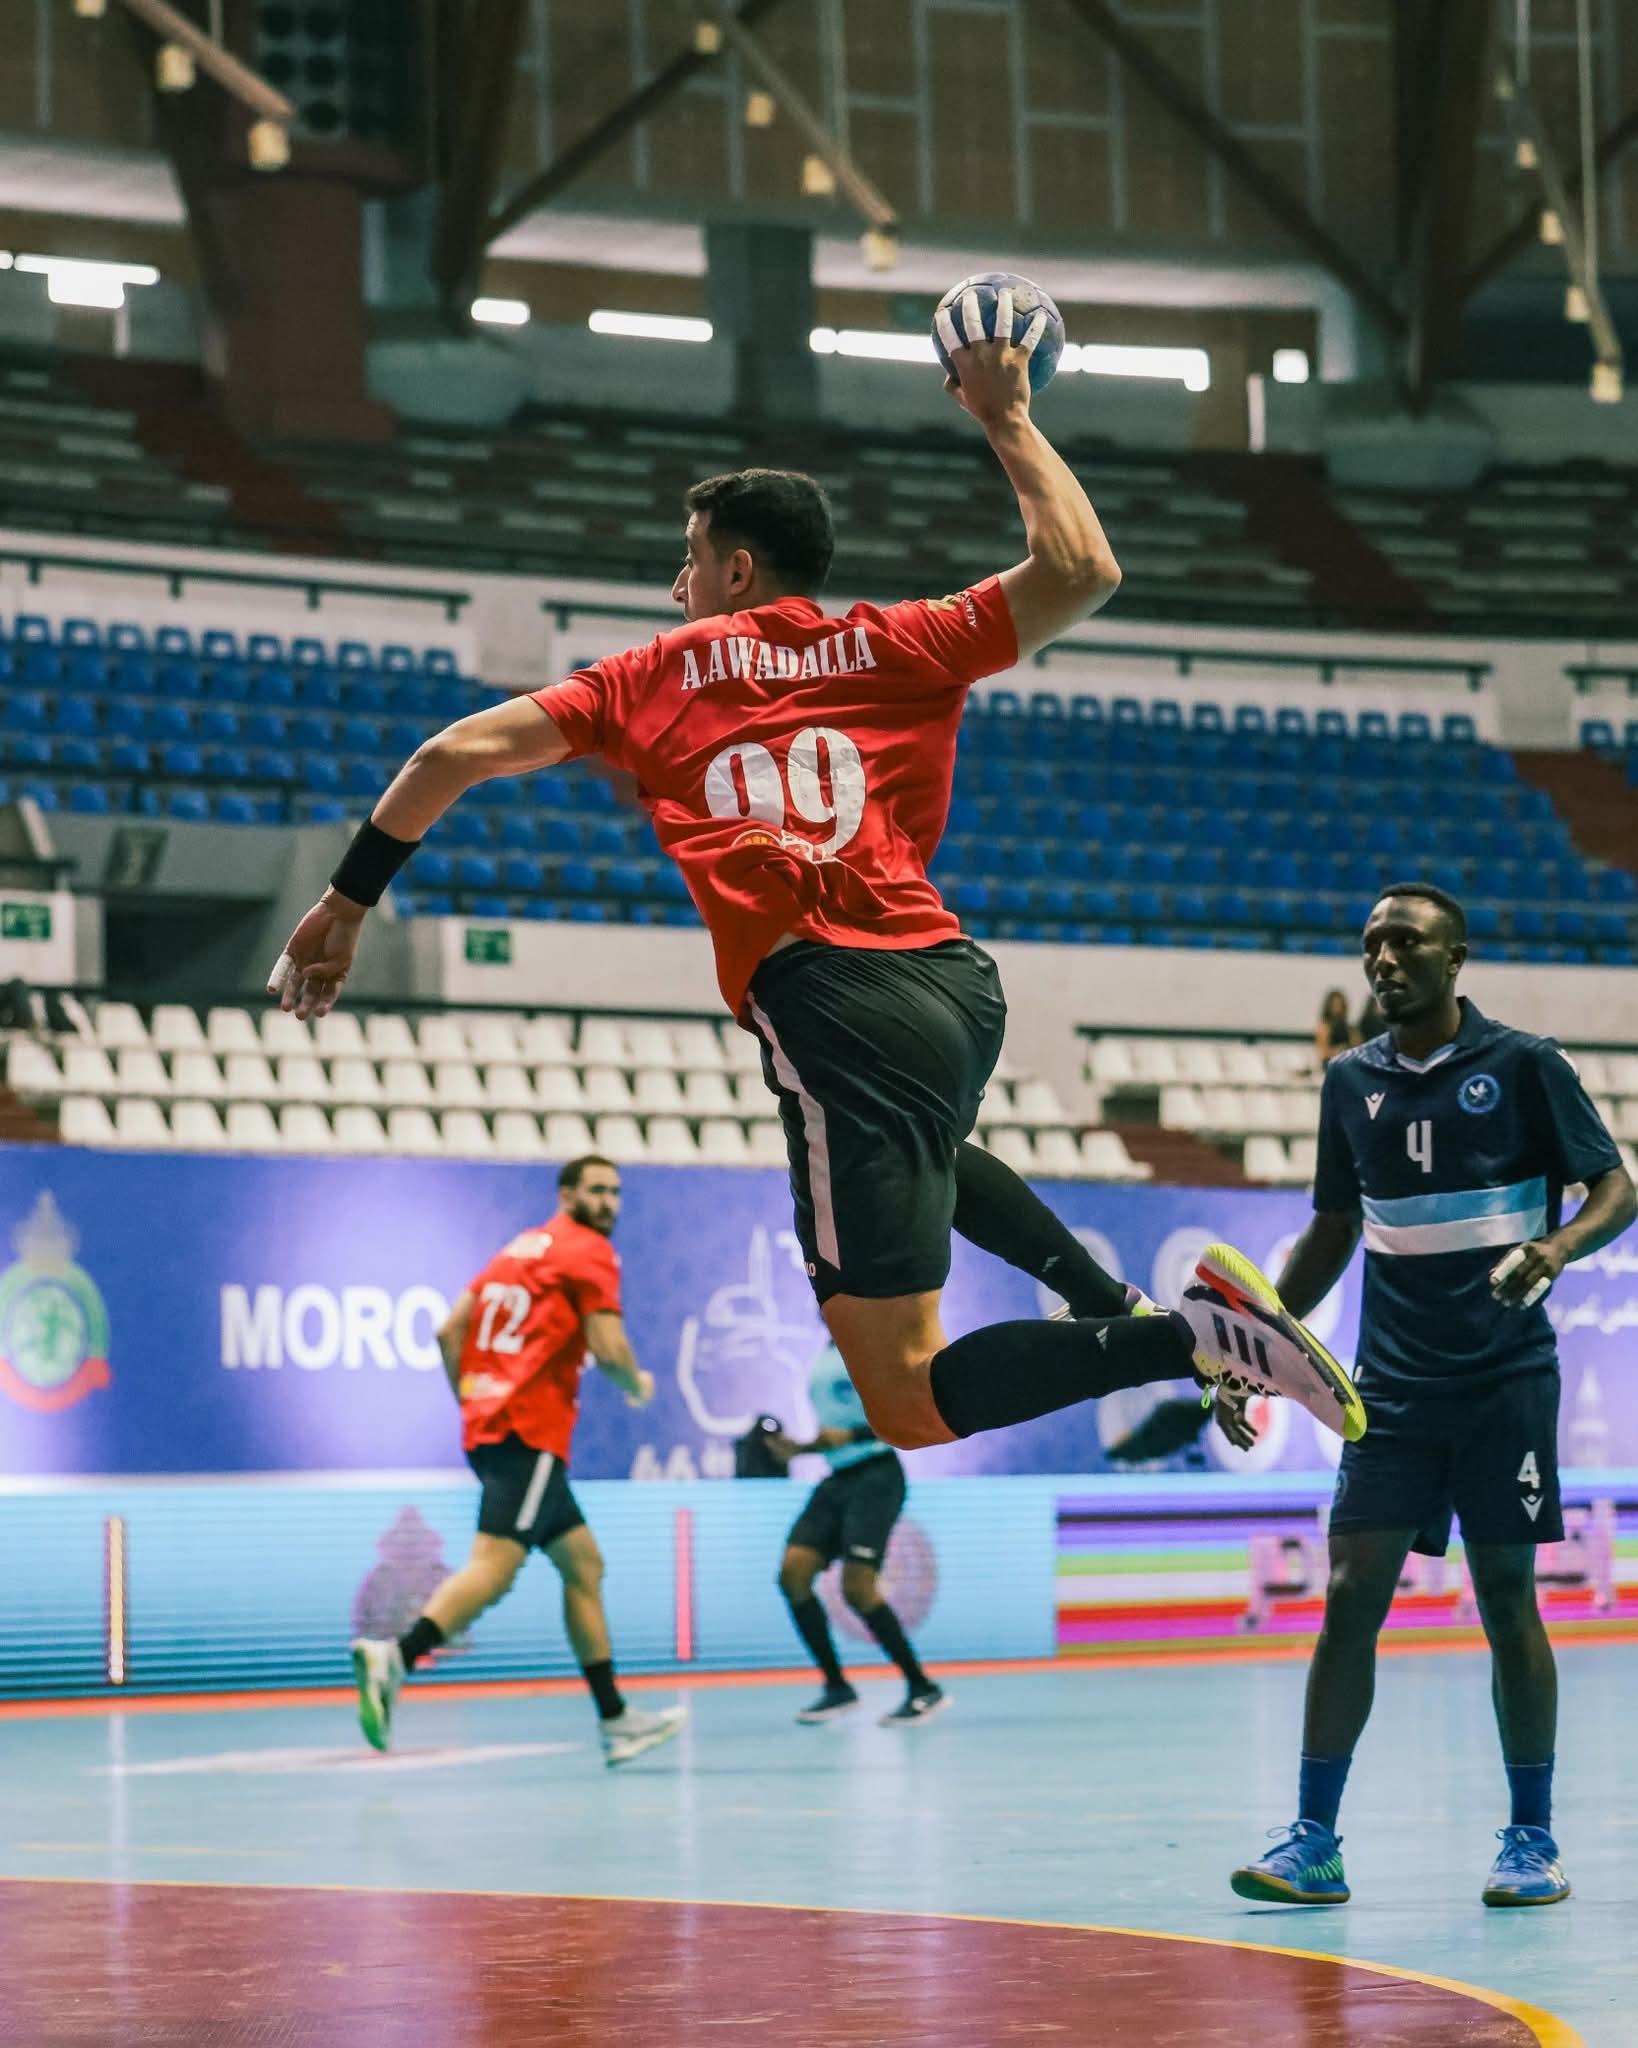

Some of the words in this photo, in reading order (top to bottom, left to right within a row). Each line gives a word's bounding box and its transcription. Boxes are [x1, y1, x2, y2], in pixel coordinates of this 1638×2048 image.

[681, 626, 877, 691] A.AWADALLA
[705, 727, 866, 857] 09
[1407, 1120, 1432, 1173] 4
[220, 1284, 450, 1371] MORO
[476, 1282, 531, 1354] 72
[1517, 1451, 1541, 1489] 4
